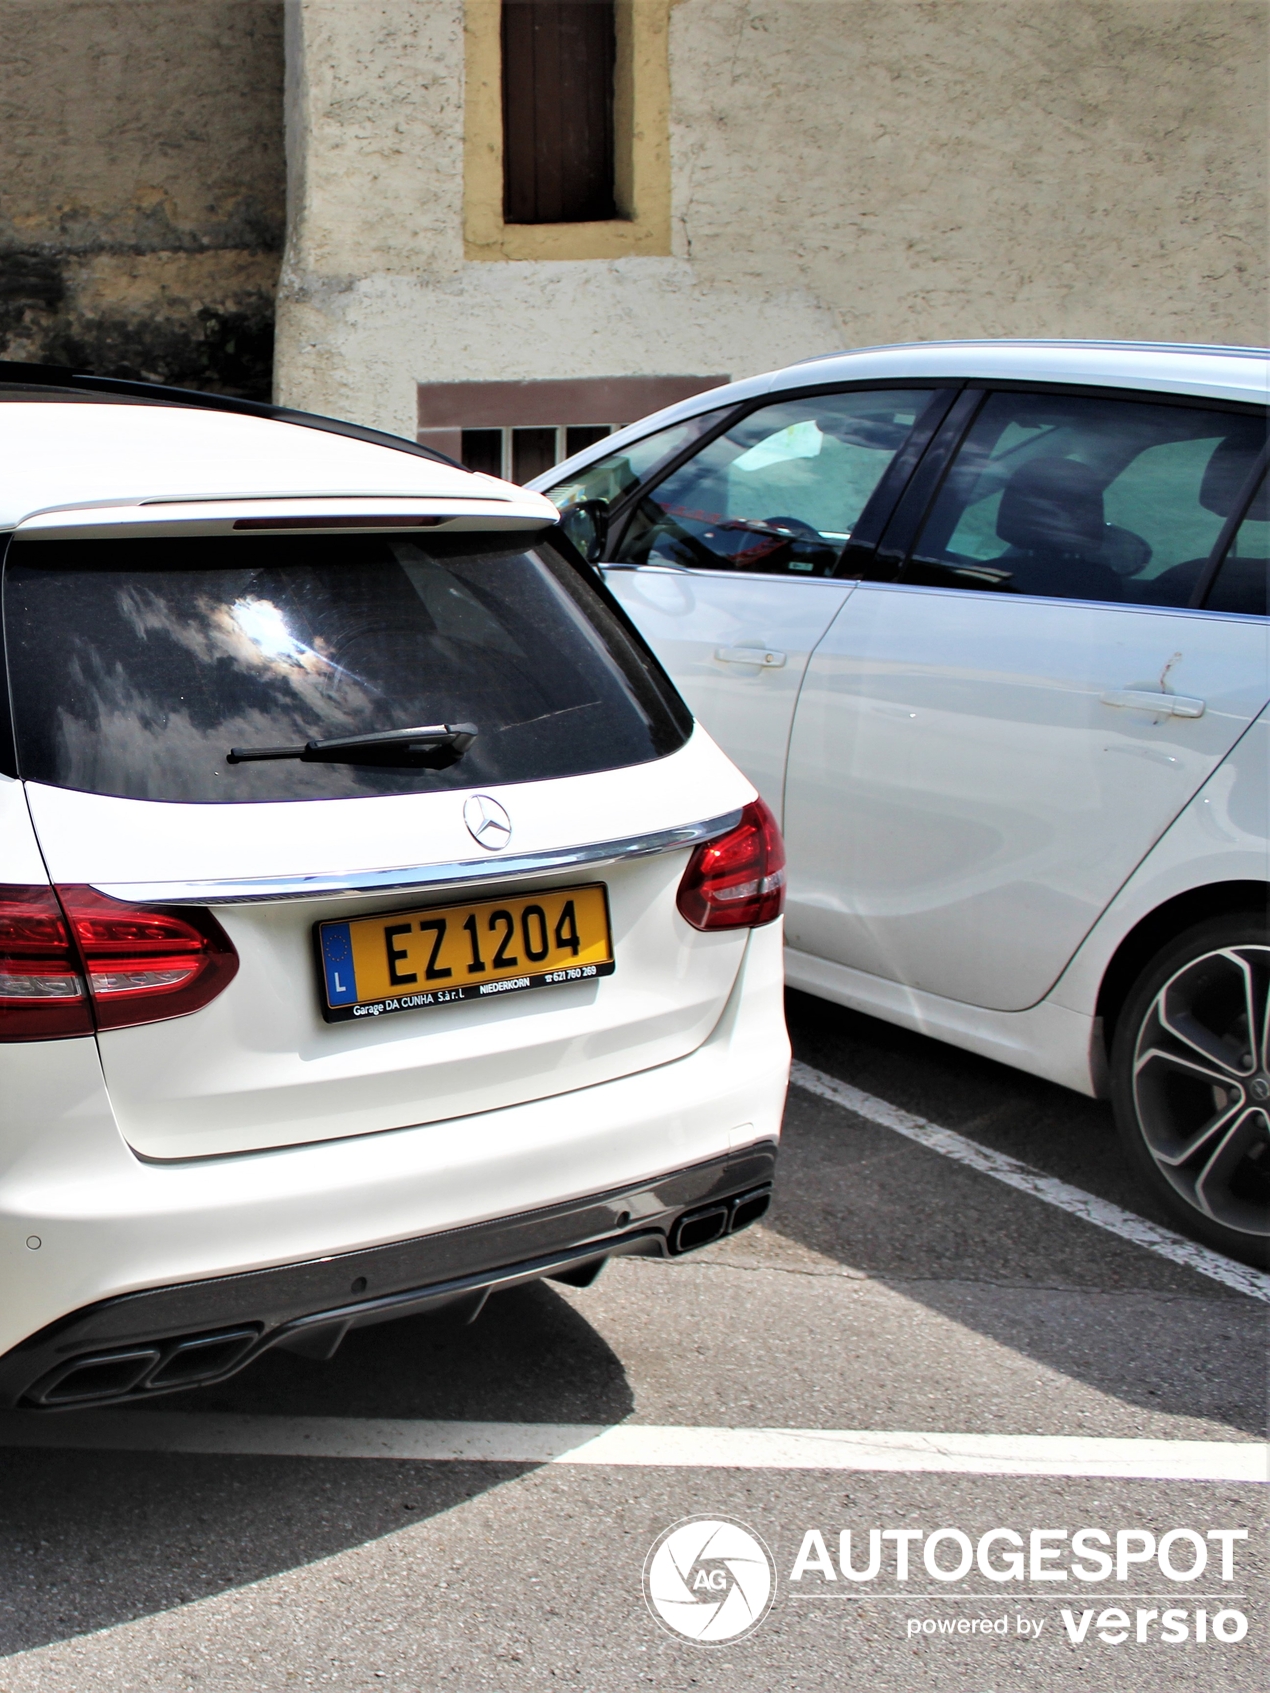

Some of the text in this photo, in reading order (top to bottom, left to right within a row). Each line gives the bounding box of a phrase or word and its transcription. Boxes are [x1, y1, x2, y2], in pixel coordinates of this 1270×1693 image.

[335, 972, 346, 992] L
[353, 1003, 384, 1016] Garage
[386, 999, 400, 1011] DA
[401, 994, 434, 1008] CUNHA
[479, 977, 530, 994] NIEDERKORN
[553, 973, 566, 982] 621
[567, 969, 581, 980] 760
[582, 965, 597, 976] 269
